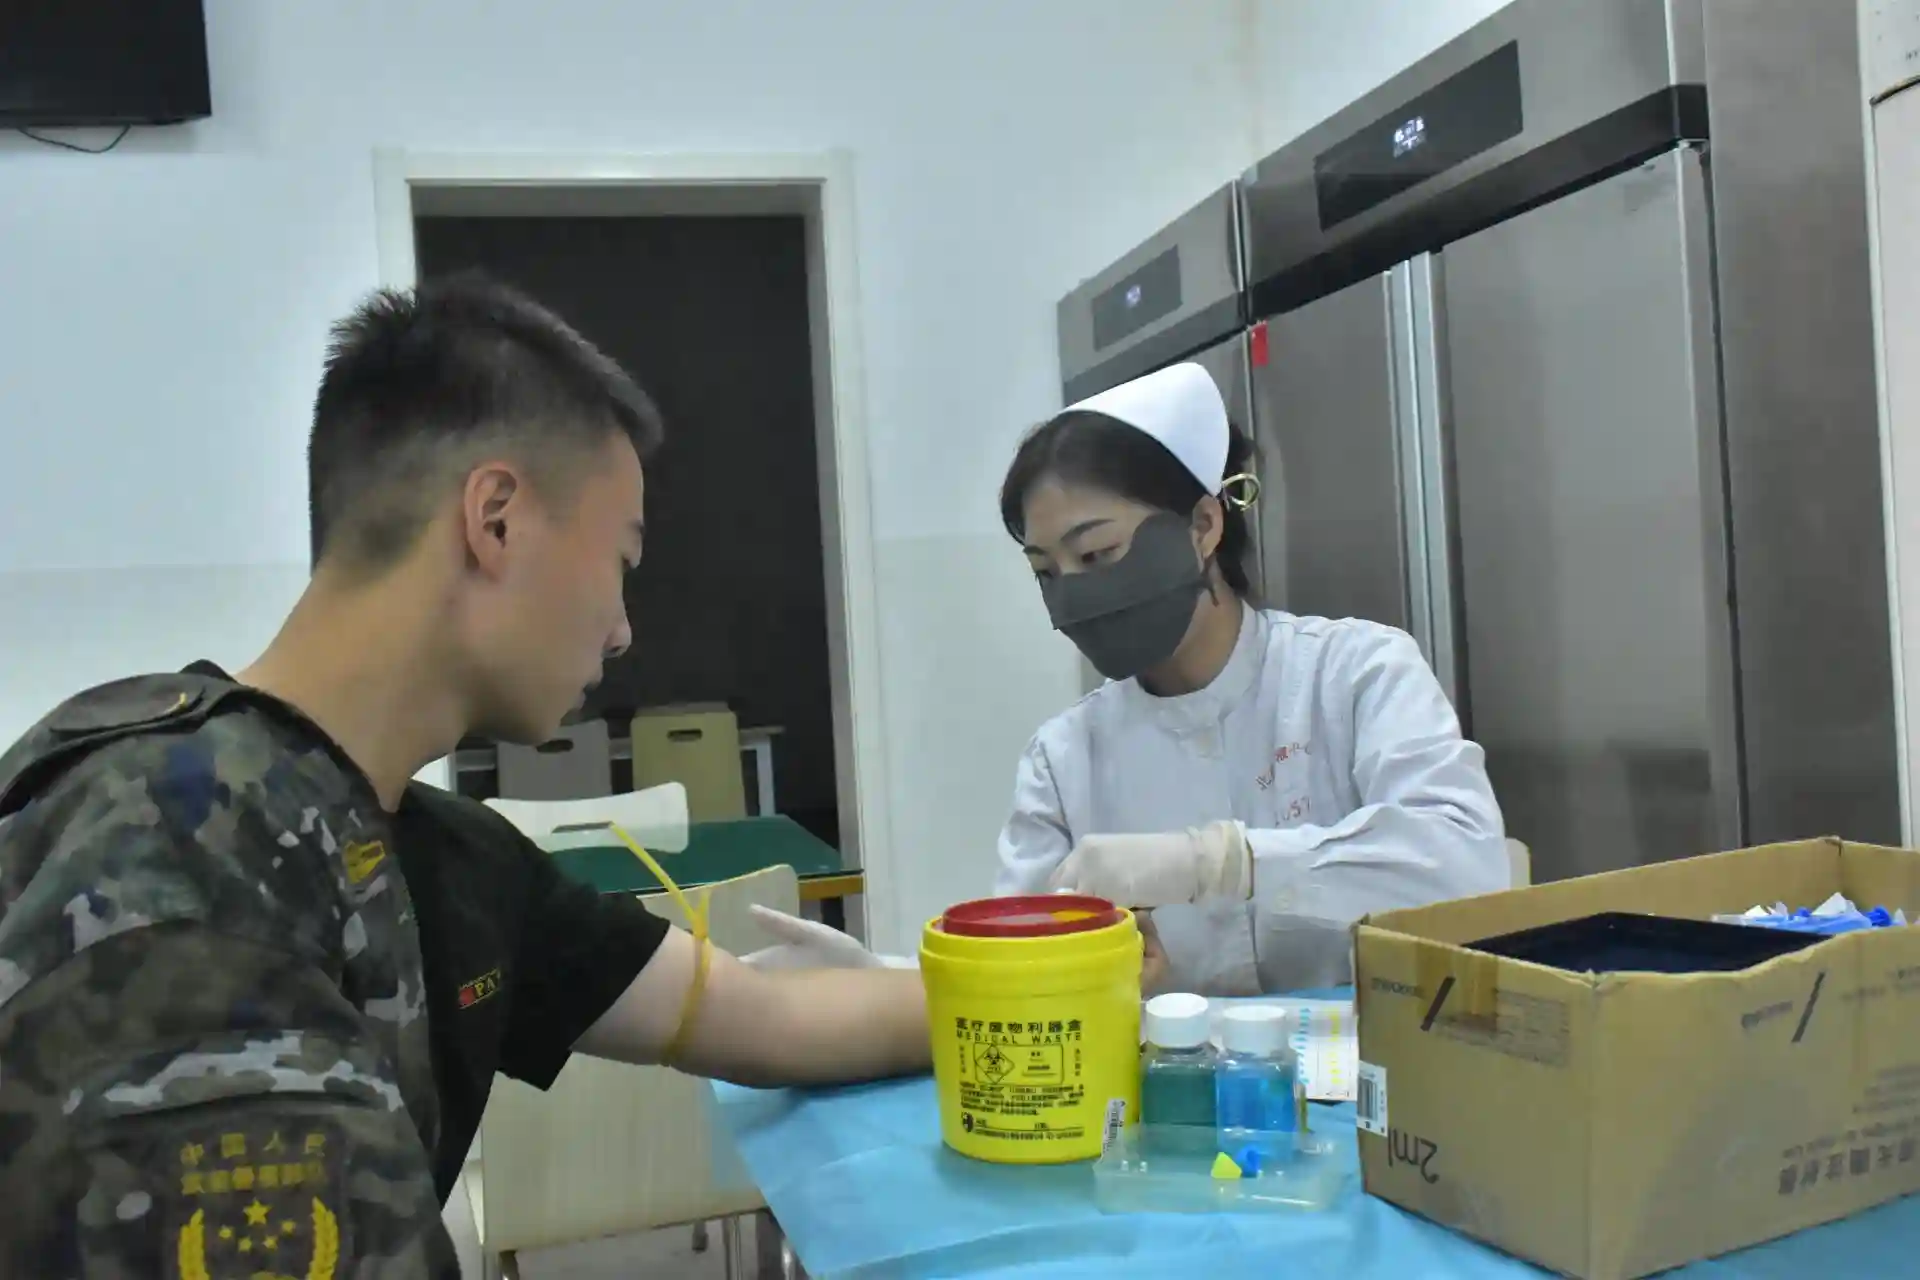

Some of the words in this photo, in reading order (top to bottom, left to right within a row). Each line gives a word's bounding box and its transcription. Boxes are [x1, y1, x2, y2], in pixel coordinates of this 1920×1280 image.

[956, 1030, 1018, 1044] MEDICAL
[1031, 1032, 1082, 1044] WASTE
[1387, 1128, 1439, 1184] 2ml
